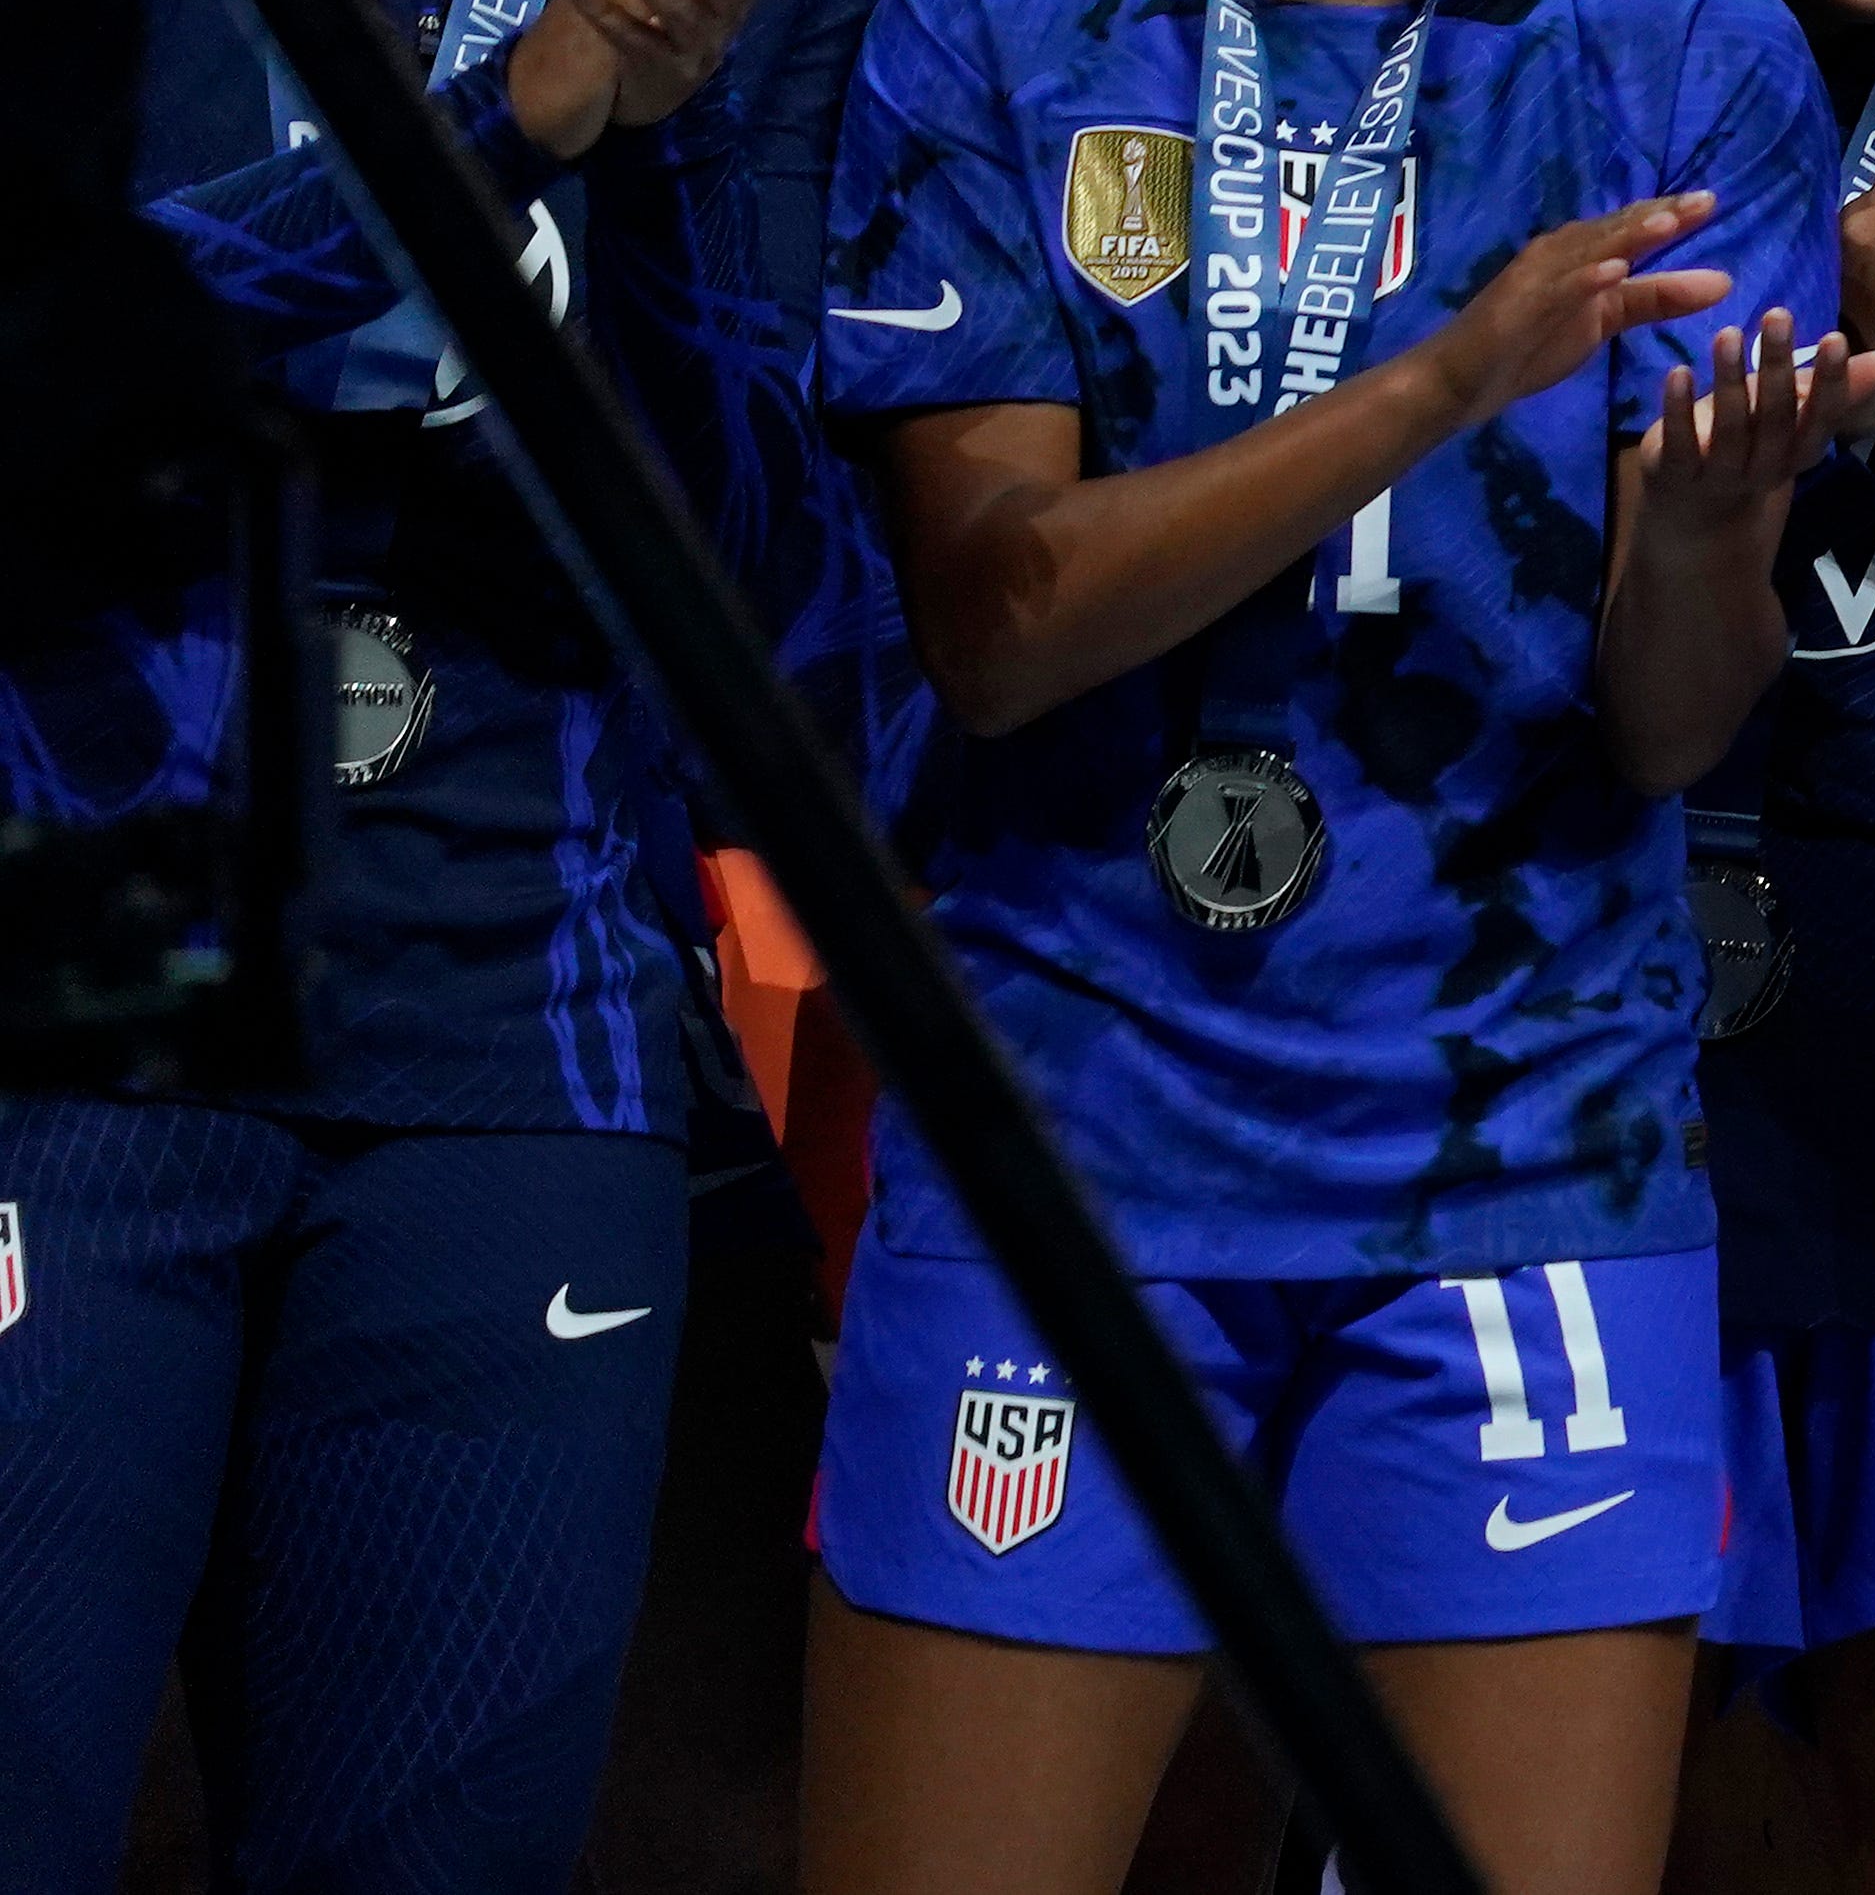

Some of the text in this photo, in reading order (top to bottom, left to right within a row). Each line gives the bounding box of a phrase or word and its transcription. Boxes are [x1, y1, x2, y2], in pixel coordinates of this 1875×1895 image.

[1101, 235, 1160, 258] FIFA
[1111, 266, 1149, 280] 2019
[1206, 252, 1263, 407] 2023
[1439, 1260, 1628, 1461] 11
[962, 1399, 1065, 1458] USA
